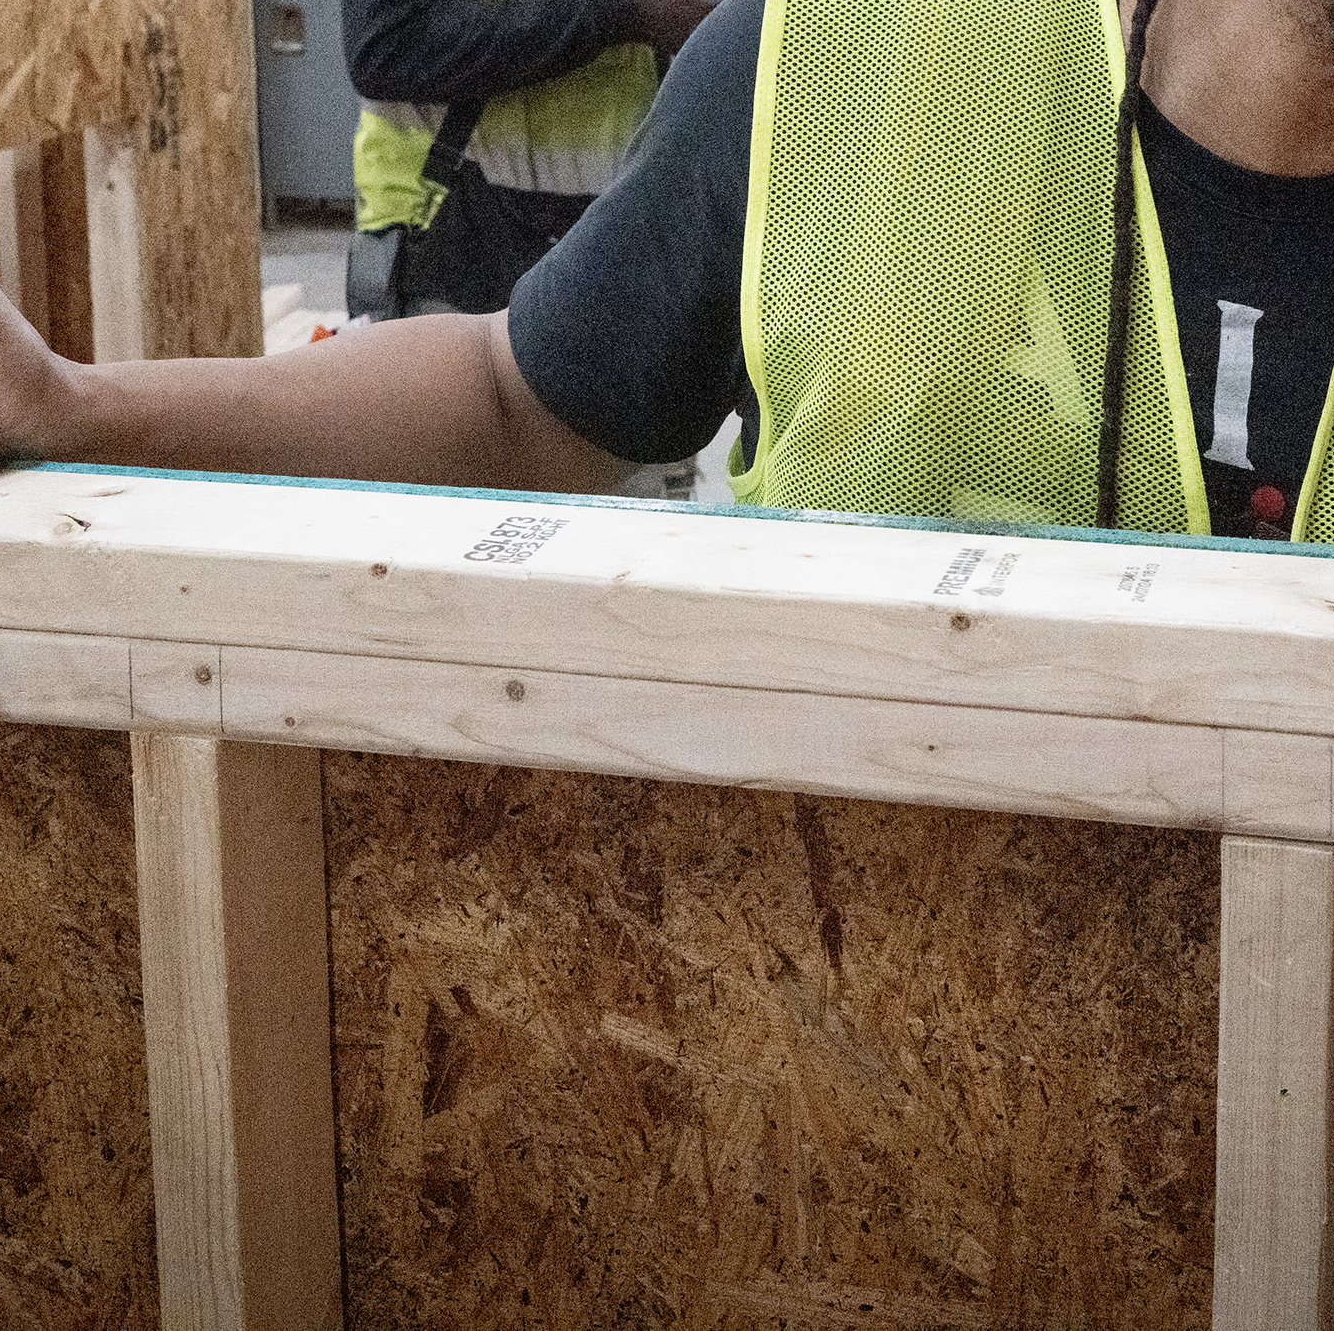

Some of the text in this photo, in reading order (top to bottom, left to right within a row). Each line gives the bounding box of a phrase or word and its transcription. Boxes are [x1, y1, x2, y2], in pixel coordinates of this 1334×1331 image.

[490, 516, 537, 538] 873
[492, 541, 528, 564] NLGA
[933, 548, 987, 596] PREMIUM
[987, 552, 1022, 587] INTERFOR
